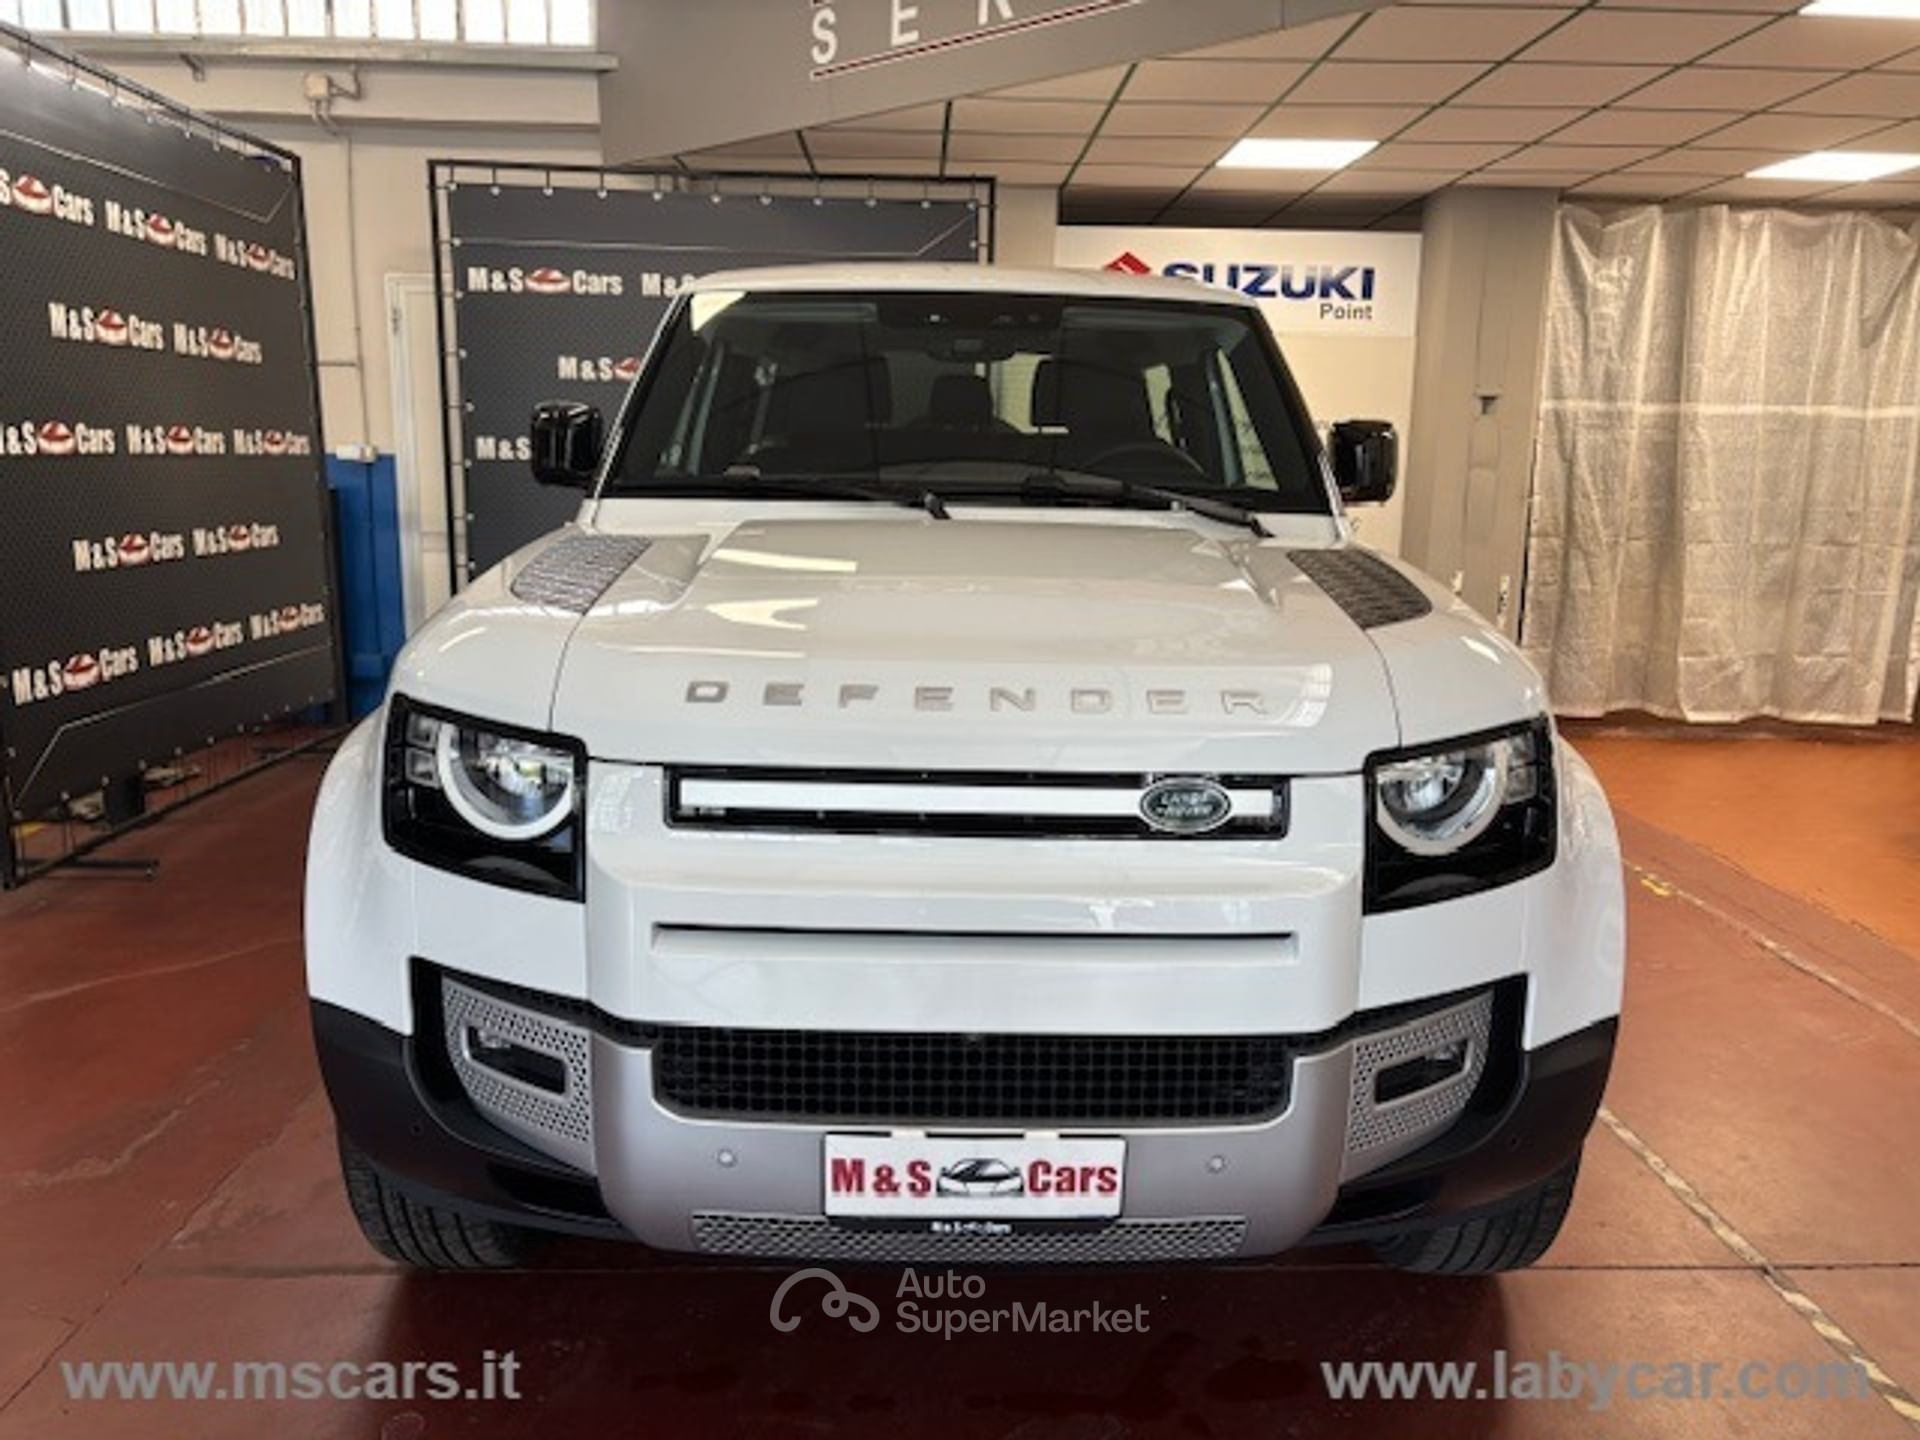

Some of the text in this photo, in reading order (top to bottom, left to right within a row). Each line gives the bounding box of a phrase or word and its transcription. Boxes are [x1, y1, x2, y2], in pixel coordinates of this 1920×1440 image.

[52, 185, 95, 226] Cars
[175, 222, 207, 256] Cars
[572, 270, 623, 294] Cars
[1320, 303, 1373, 320] Point
[128, 314, 163, 349] Cars
[75, 422, 115, 454] Cars
[193, 426, 226, 454] Cars
[150, 531, 184, 561] Cars
[99, 645, 139, 681] Cars
[685, 681, 1269, 715] DEFENDER
[1028, 1160, 1117, 1194] Cars
